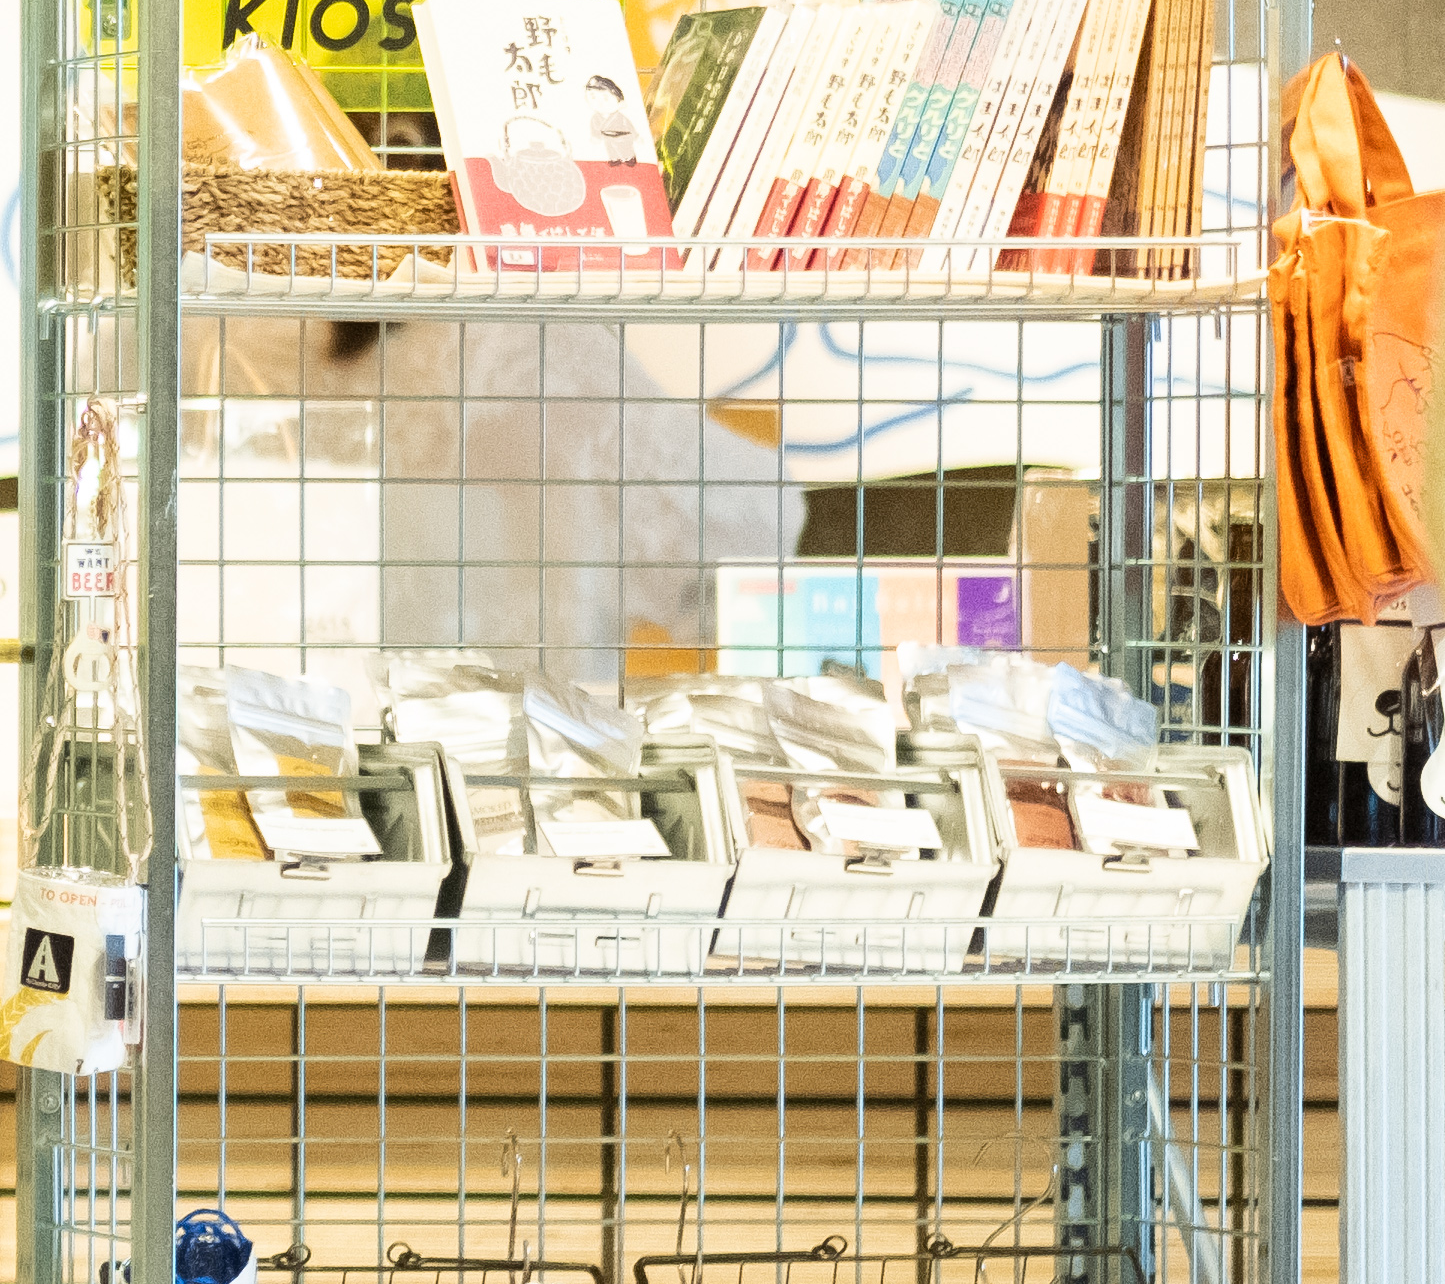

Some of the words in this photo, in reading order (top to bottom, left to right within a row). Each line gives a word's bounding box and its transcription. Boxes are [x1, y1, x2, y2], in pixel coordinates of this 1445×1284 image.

[77, 557, 111, 569] WANT
[72, 572, 115, 592] BEER
[40, 887, 55, 902] TO
[59, 890, 97, 907] OPEN
